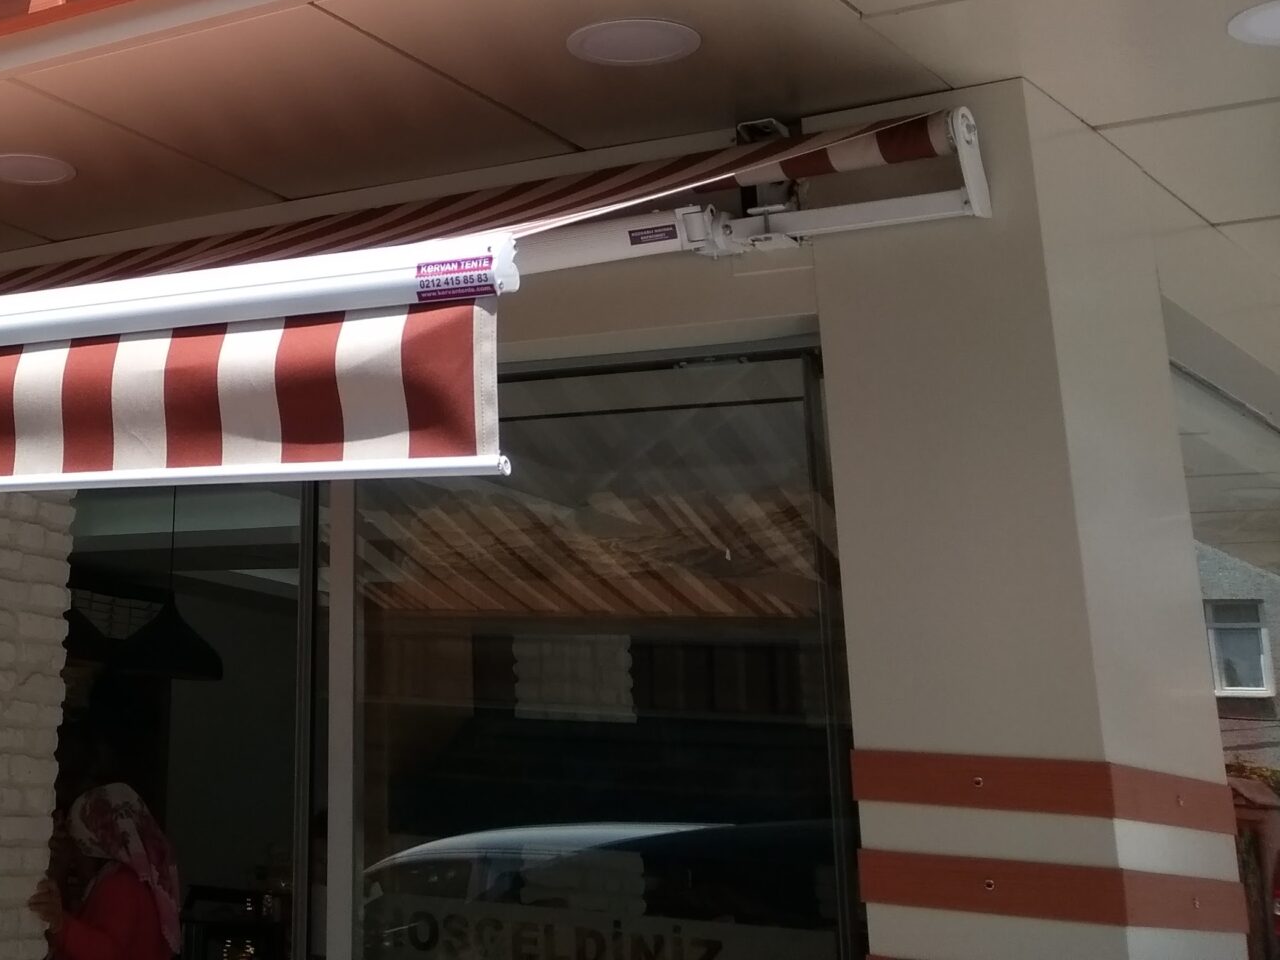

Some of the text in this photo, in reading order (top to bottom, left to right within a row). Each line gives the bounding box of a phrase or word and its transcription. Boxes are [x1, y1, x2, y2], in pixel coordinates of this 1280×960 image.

[461, 257, 489, 269] TENTE
[419, 278, 441, 289] 0212
[444, 276, 460, 287] 415
[463, 274, 474, 284] 85
